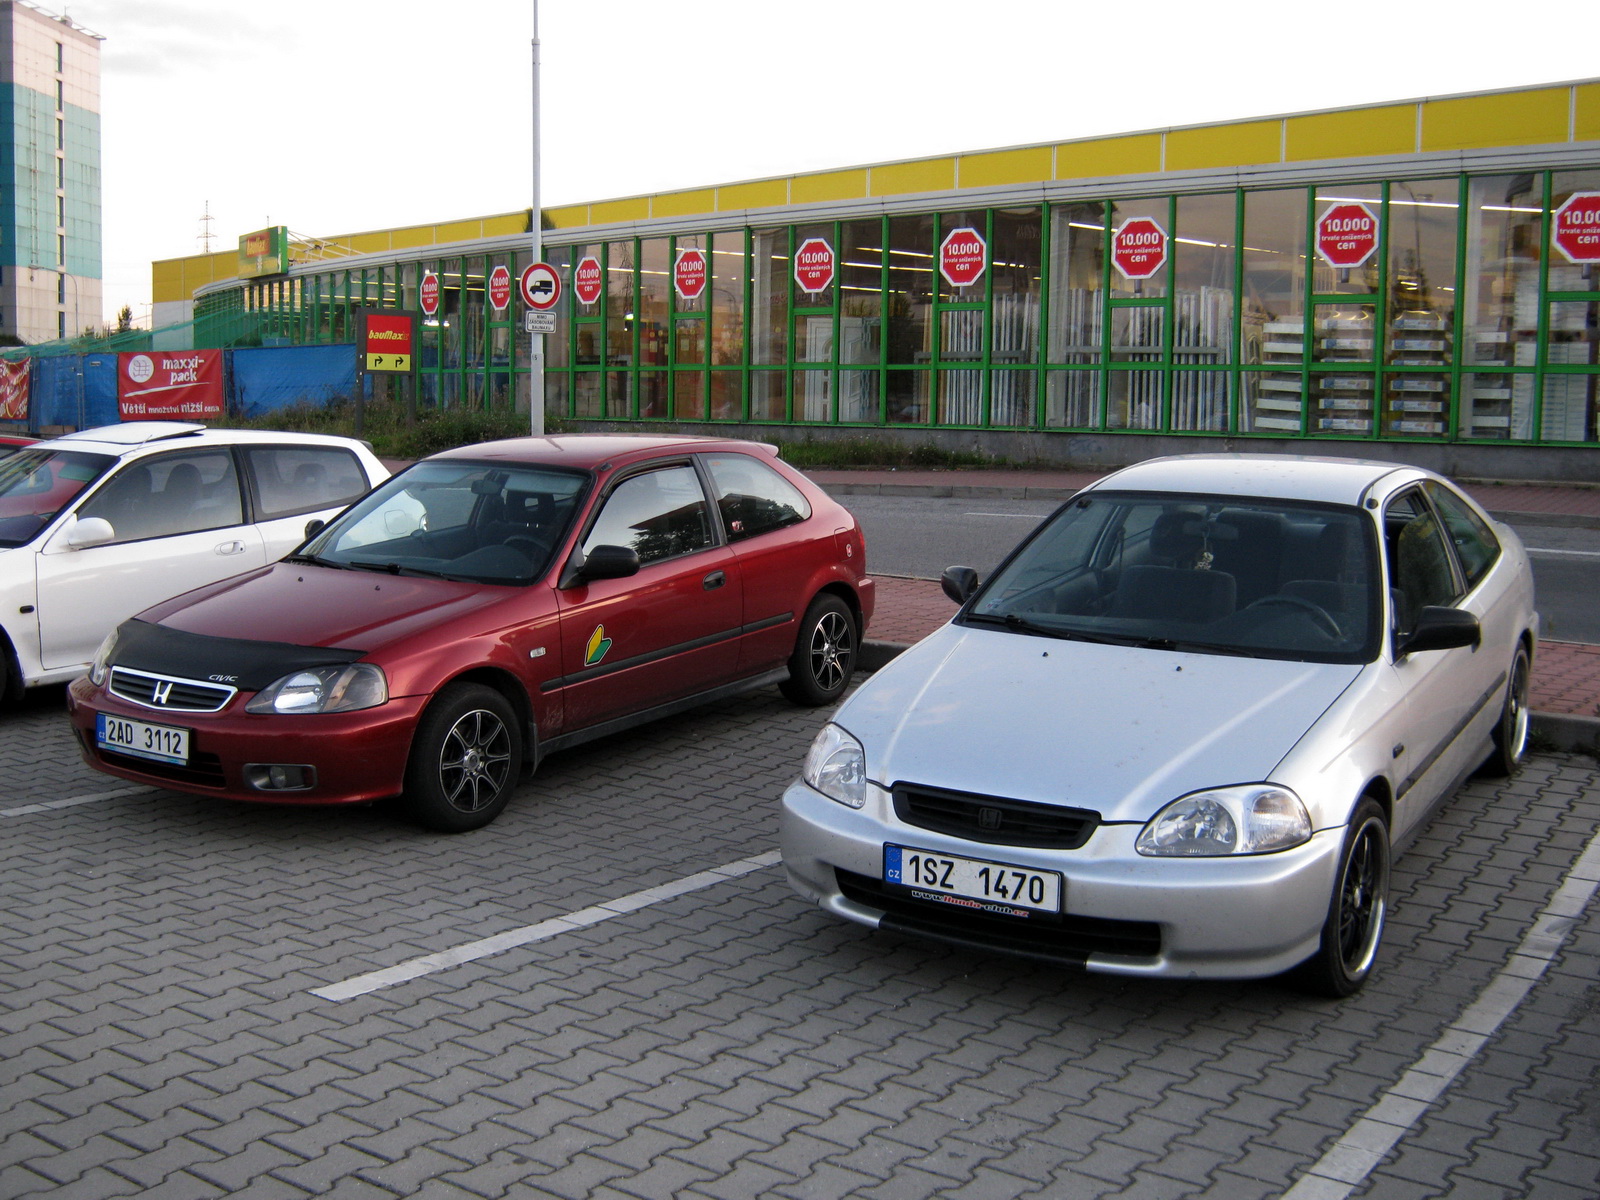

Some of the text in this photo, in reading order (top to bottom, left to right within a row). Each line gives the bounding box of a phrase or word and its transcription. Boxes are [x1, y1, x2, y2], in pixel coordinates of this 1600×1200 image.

[1325, 217, 1370, 232] 10.000
[1120, 232, 1159, 246] 10.000
[1577, 235, 1599, 244] cen
[947, 242, 980, 256] 10.000
[1337, 242, 1356, 250] cen
[801, 252, 829, 264] 10.000
[1130, 255, 1147, 263] cen
[680, 260, 703, 272] 10.000
[955, 263, 970, 271] cen
[579, 268, 599, 279] 10.000
[423, 283, 438, 293] 10.000
[492, 277, 509, 287] 10.000
[162, 355, 205, 370] maxxi-
[170, 368, 197, 386] pack
[122, 402, 146, 415] Větší
[208, 674, 239, 682] CIVIC
[107, 719, 182, 755] 2AD 3112
[887, 868, 900, 879] CZ
[909, 854, 1045, 905] 1SZ 1470
